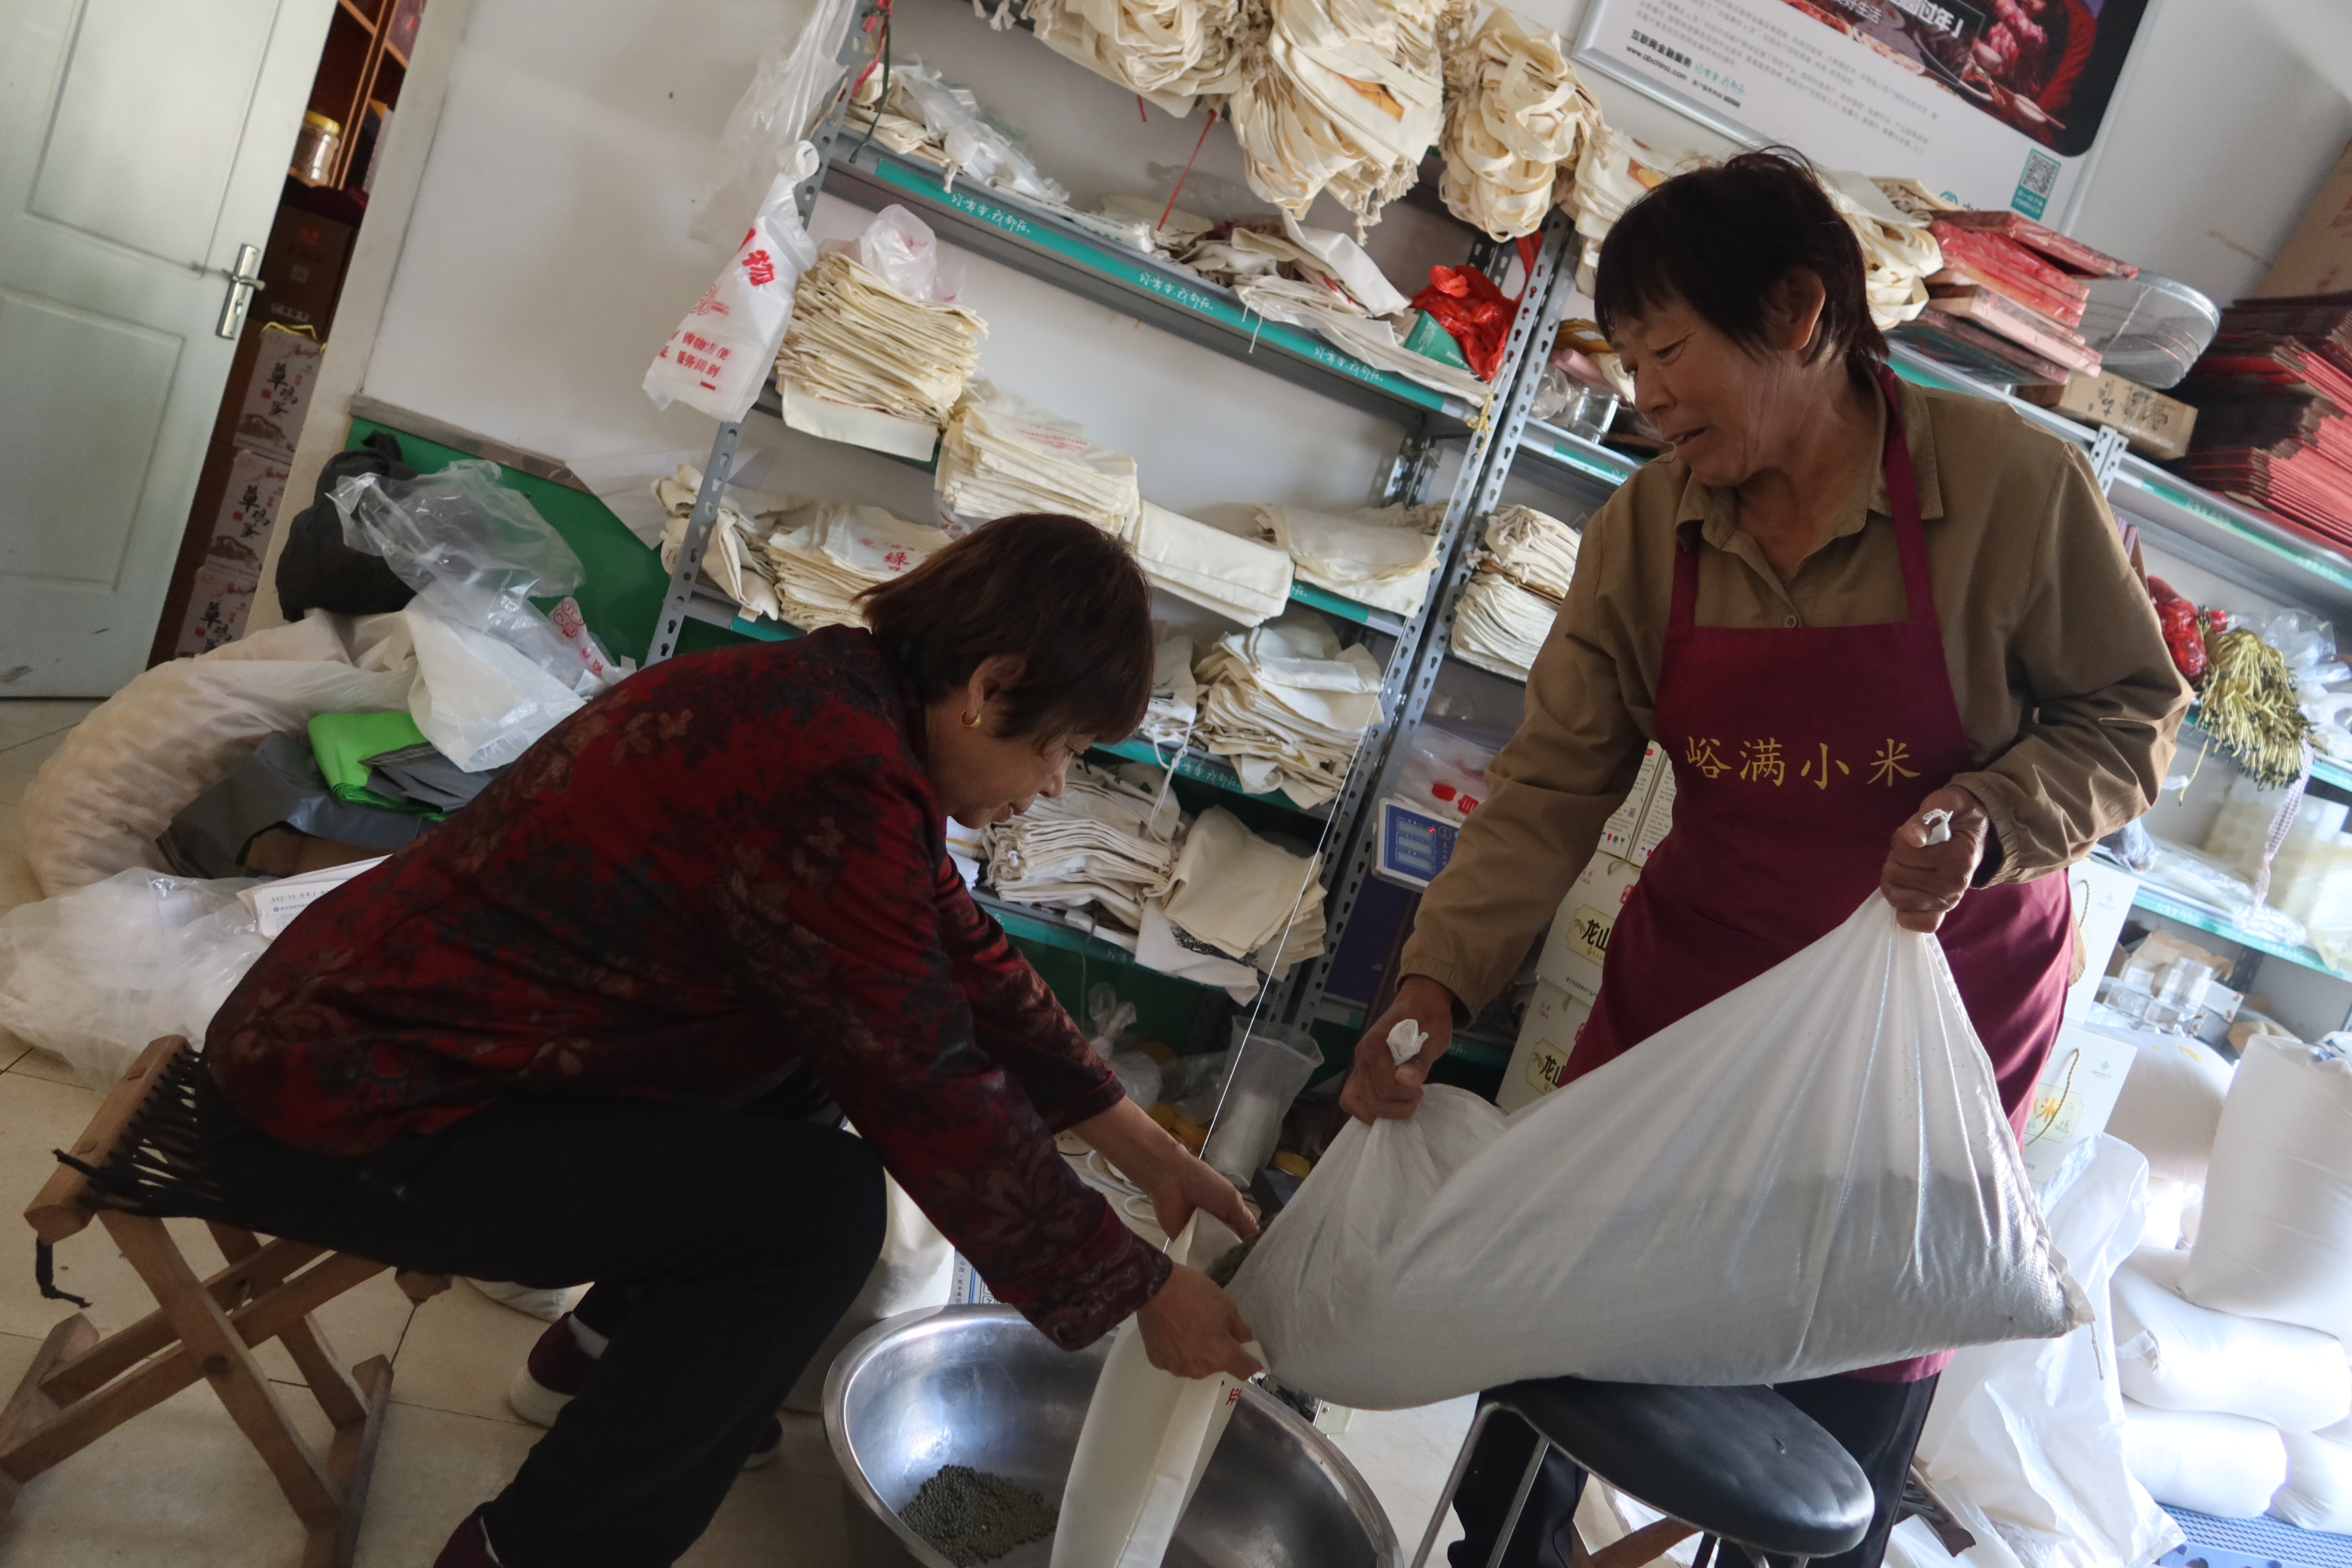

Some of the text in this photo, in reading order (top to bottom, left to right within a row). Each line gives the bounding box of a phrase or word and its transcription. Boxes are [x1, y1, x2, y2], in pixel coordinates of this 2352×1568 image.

[1837, 0, 1882, 24] 好生活
[1890, 0, 1964, 39] 圆过年」
[1626, 45, 1688, 81] www.abchina.com
[1631, 28, 1693, 67] 互联网金融服务
[682, 331, 732, 360] 购物方便
[1686, 736, 1921, 790] 峪满小米
[1581, 918, 1609, 951] 龙山
